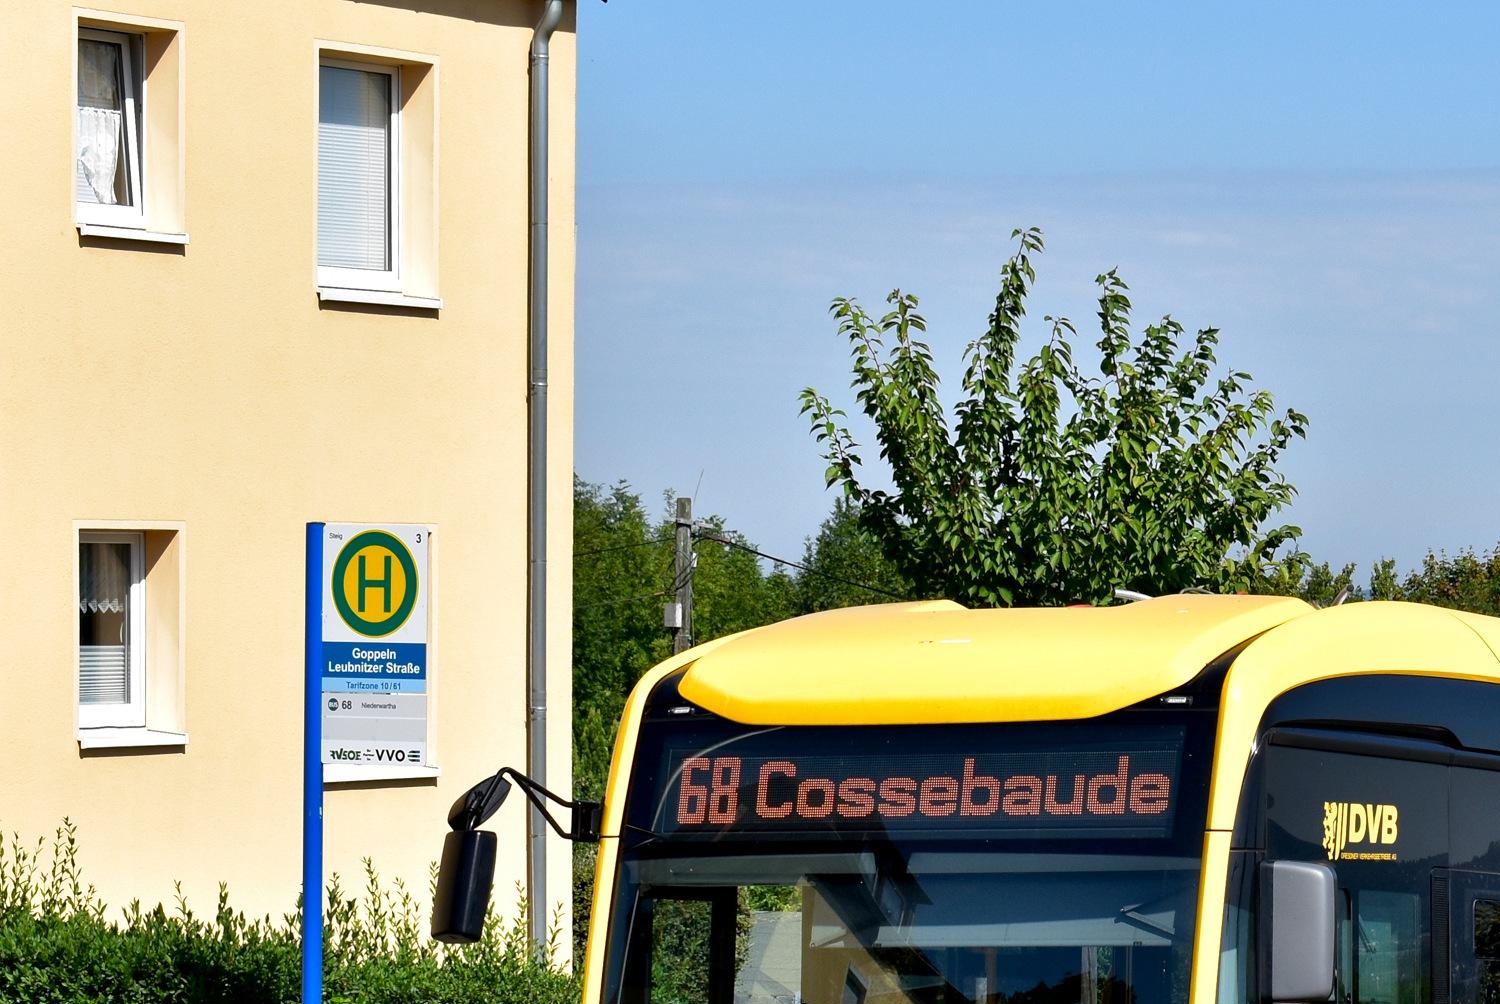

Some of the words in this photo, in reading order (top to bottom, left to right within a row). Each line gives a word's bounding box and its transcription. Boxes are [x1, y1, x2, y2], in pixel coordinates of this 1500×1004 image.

[329, 532, 343, 540] Steig
[416, 533, 422, 543] 3
[358, 555, 392, 613] H
[352, 648, 397, 661] Goppeln
[328, 661, 384, 673] Leubnitzer
[386, 662, 421, 674] Straße
[346, 681, 379, 690] Tarifzone
[341, 700, 352, 709] 68
[375, 749, 406, 762] VVO
[676, 757, 741, 824] 68
[754, 755, 1171, 819] Cossebaude
[1348, 803, 1398, 845] DVB
